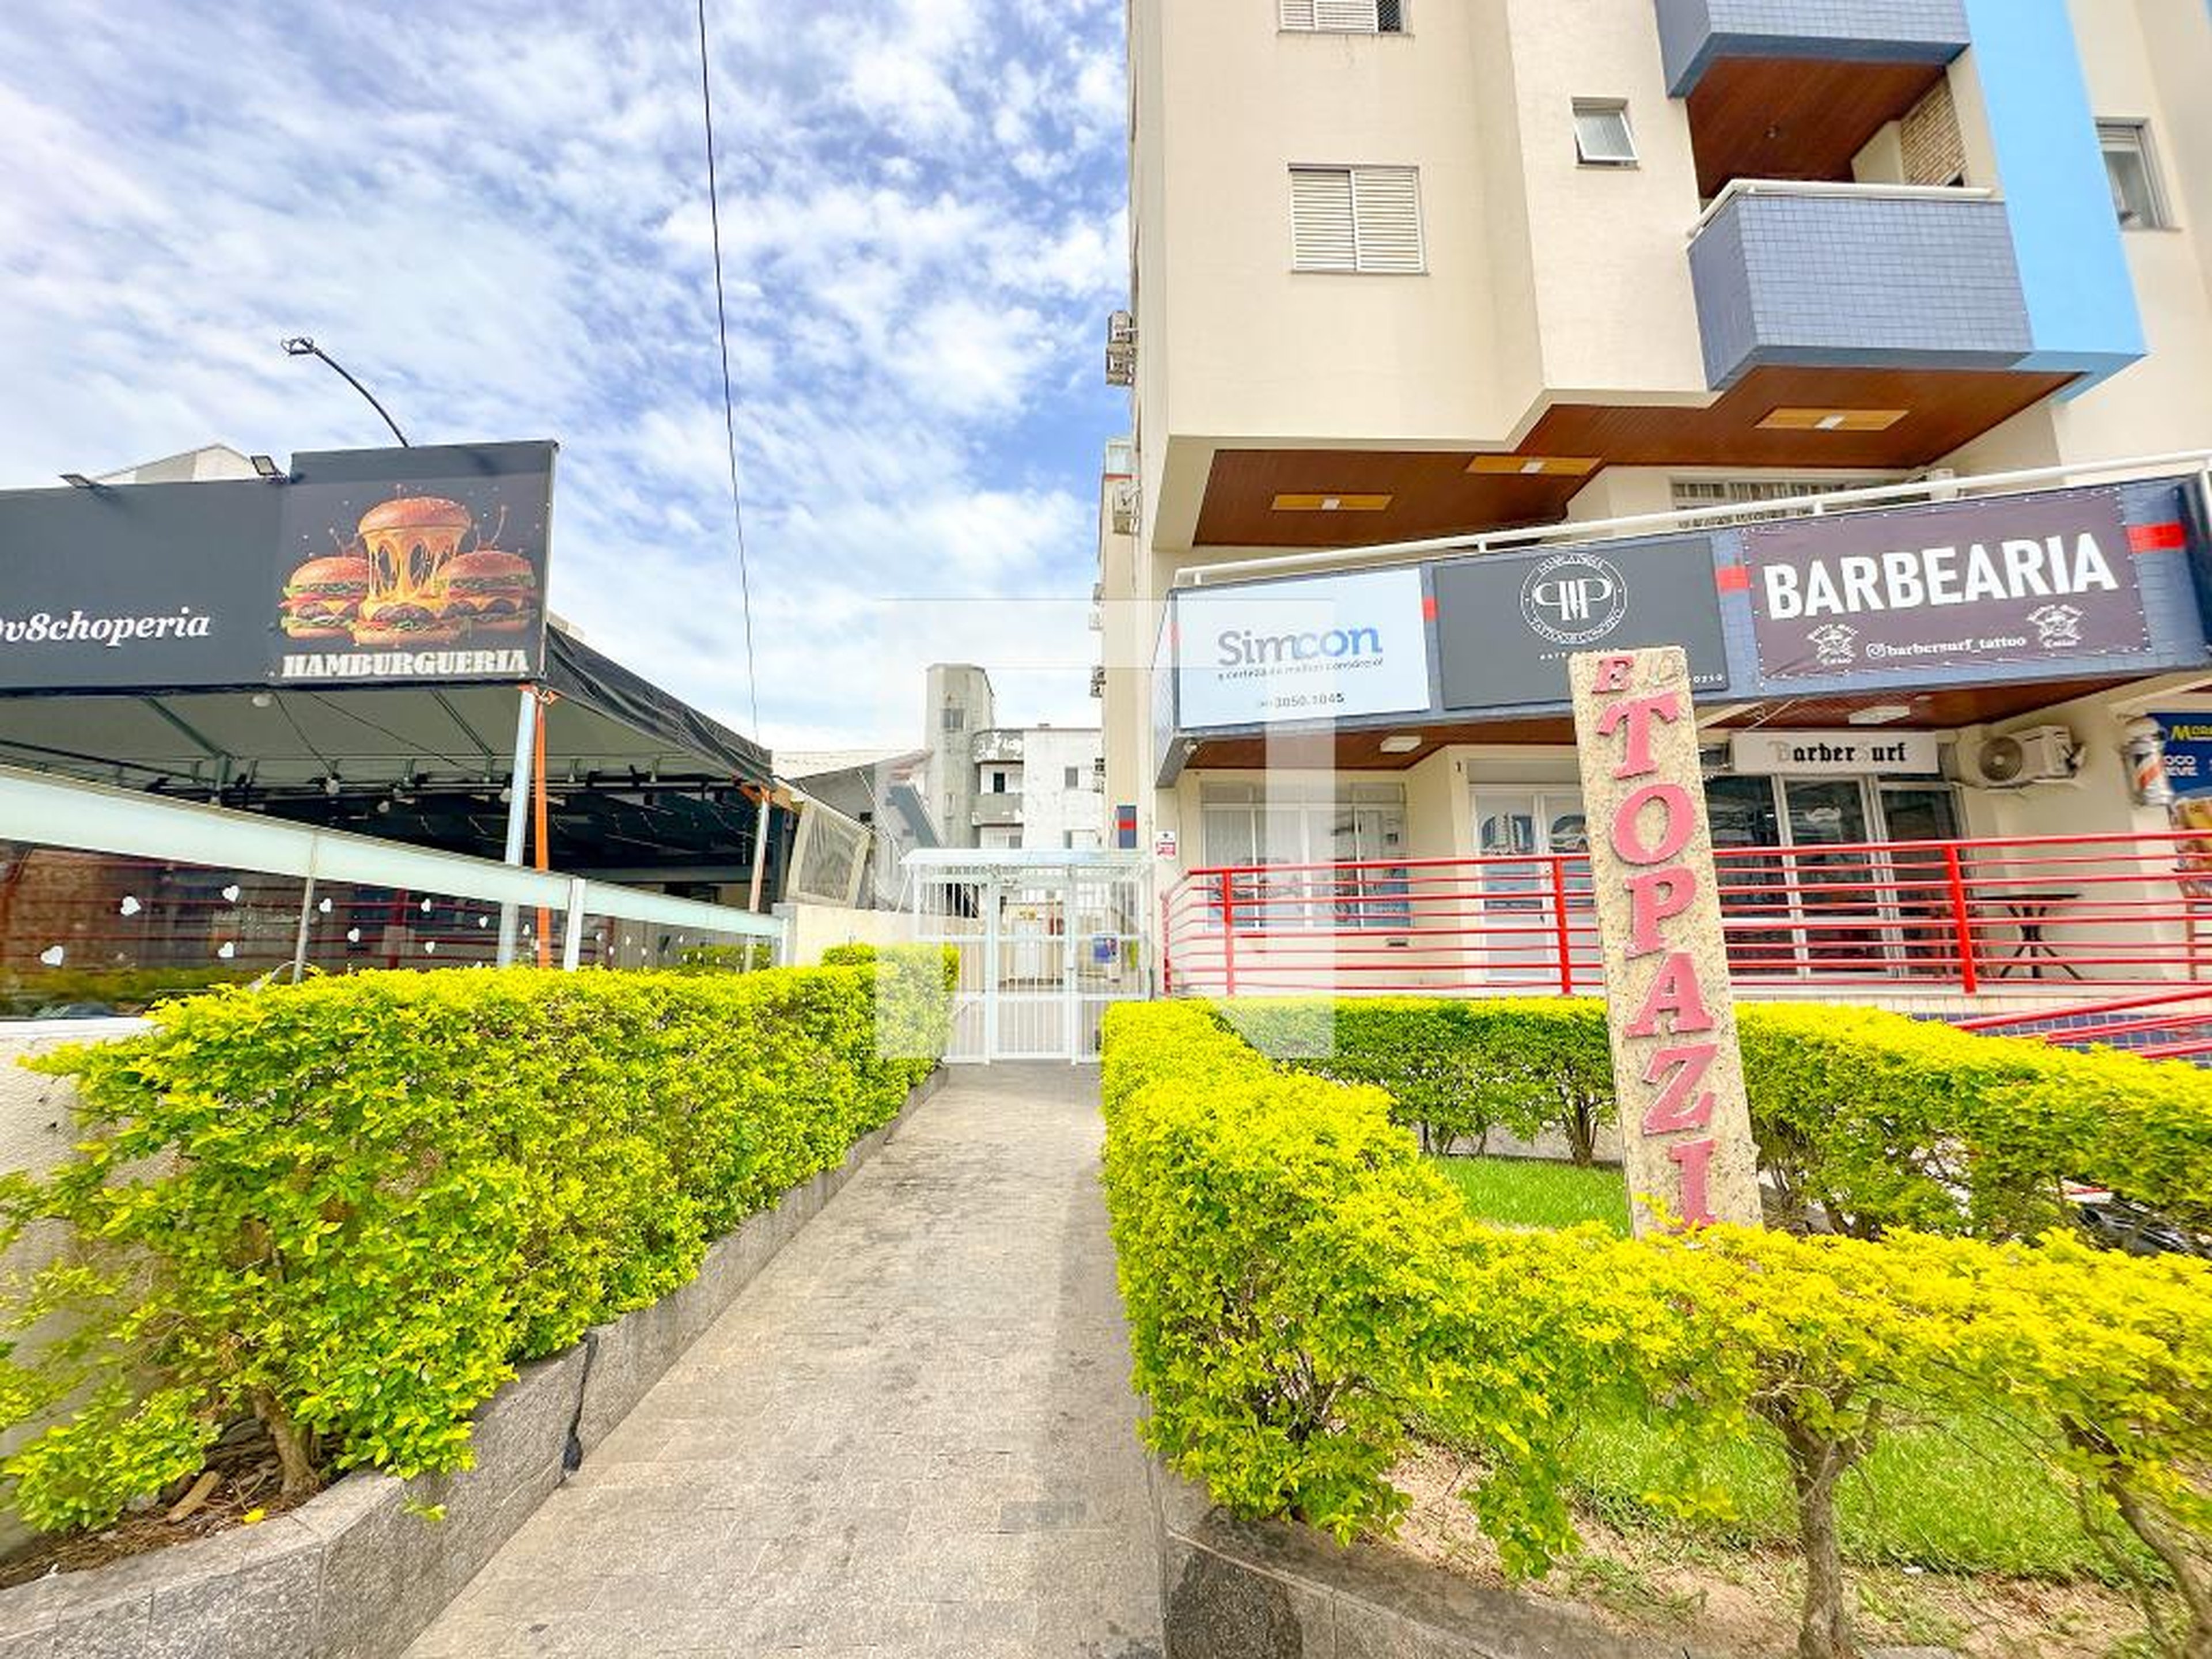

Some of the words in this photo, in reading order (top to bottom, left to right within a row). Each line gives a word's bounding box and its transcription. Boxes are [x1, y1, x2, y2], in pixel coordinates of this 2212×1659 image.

[1763, 532, 2119, 620] BARBEARIA
[0, 606, 211, 647] v8choperia
[1218, 627, 1383, 666] Simcon
[281, 649, 529, 678] HAMBURGUERIA
